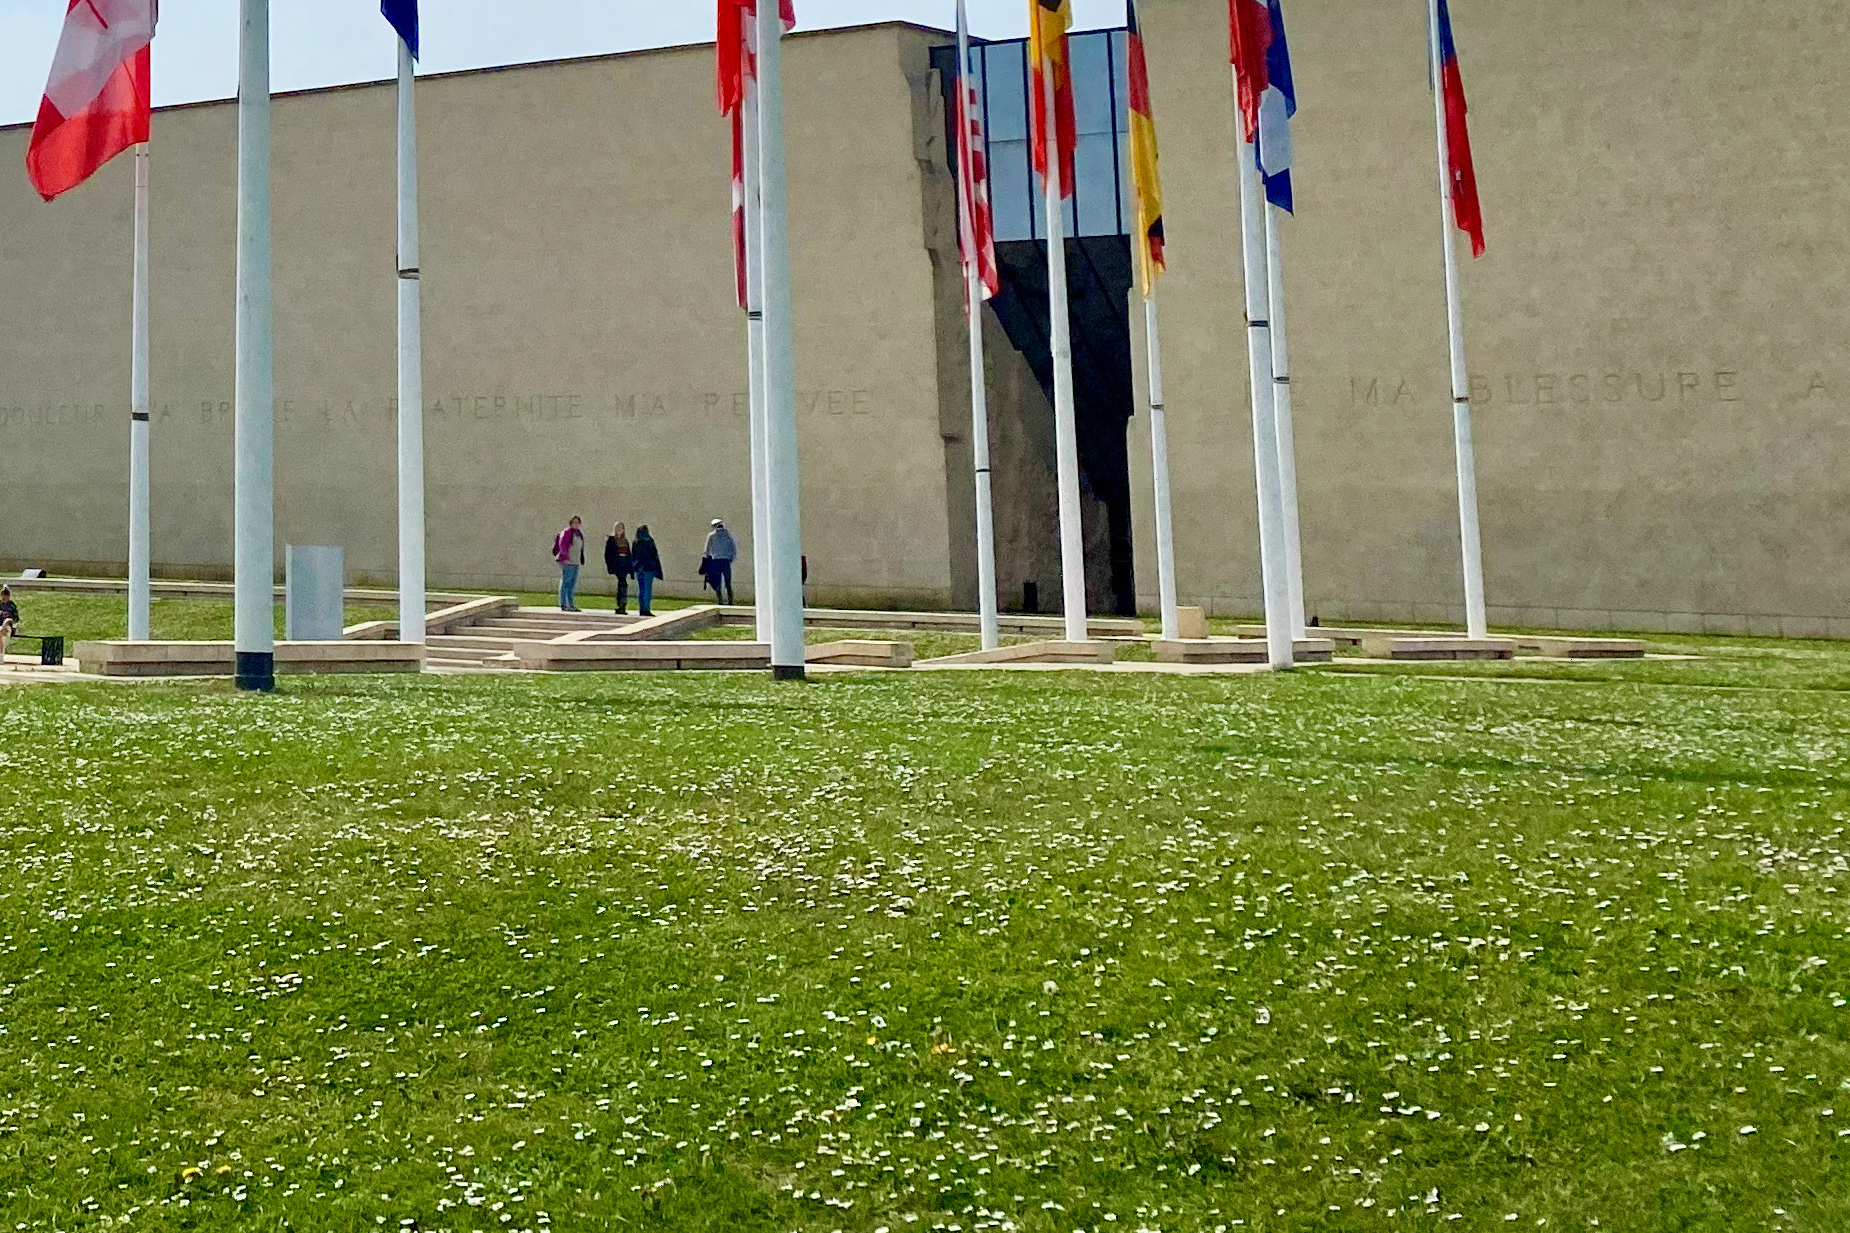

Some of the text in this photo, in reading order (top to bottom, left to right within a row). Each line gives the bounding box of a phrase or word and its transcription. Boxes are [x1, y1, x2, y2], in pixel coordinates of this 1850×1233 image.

[387, 394, 583, 421] FATERNITE
[703, 388, 870, 418] REVEE
[1349, 369, 1838, 406] MA BLESSURE A
